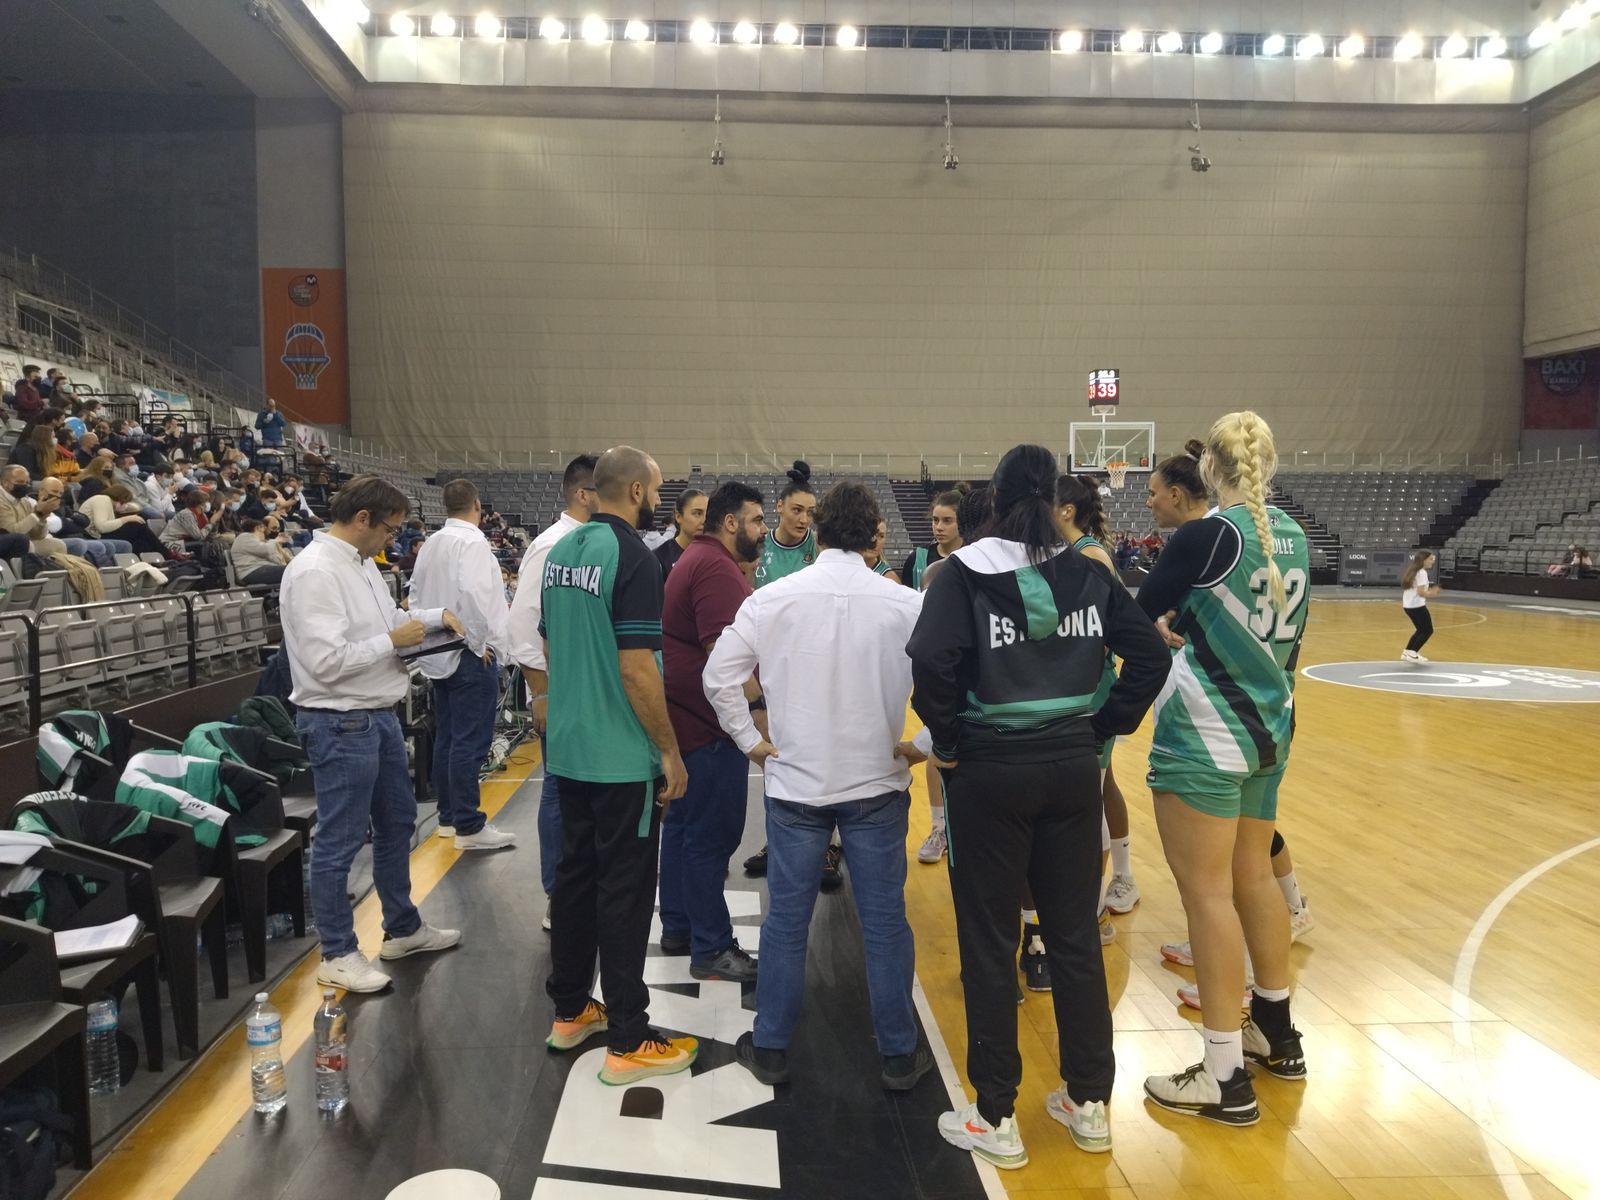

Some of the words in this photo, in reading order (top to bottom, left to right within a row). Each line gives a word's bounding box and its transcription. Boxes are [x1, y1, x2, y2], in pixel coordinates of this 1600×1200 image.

[1097, 383, 1117, 397] 39
[1273, 537, 1295, 555] OLLE
[1248, 567, 1307, 643] 32
[989, 604, 1104, 649] ESONA
